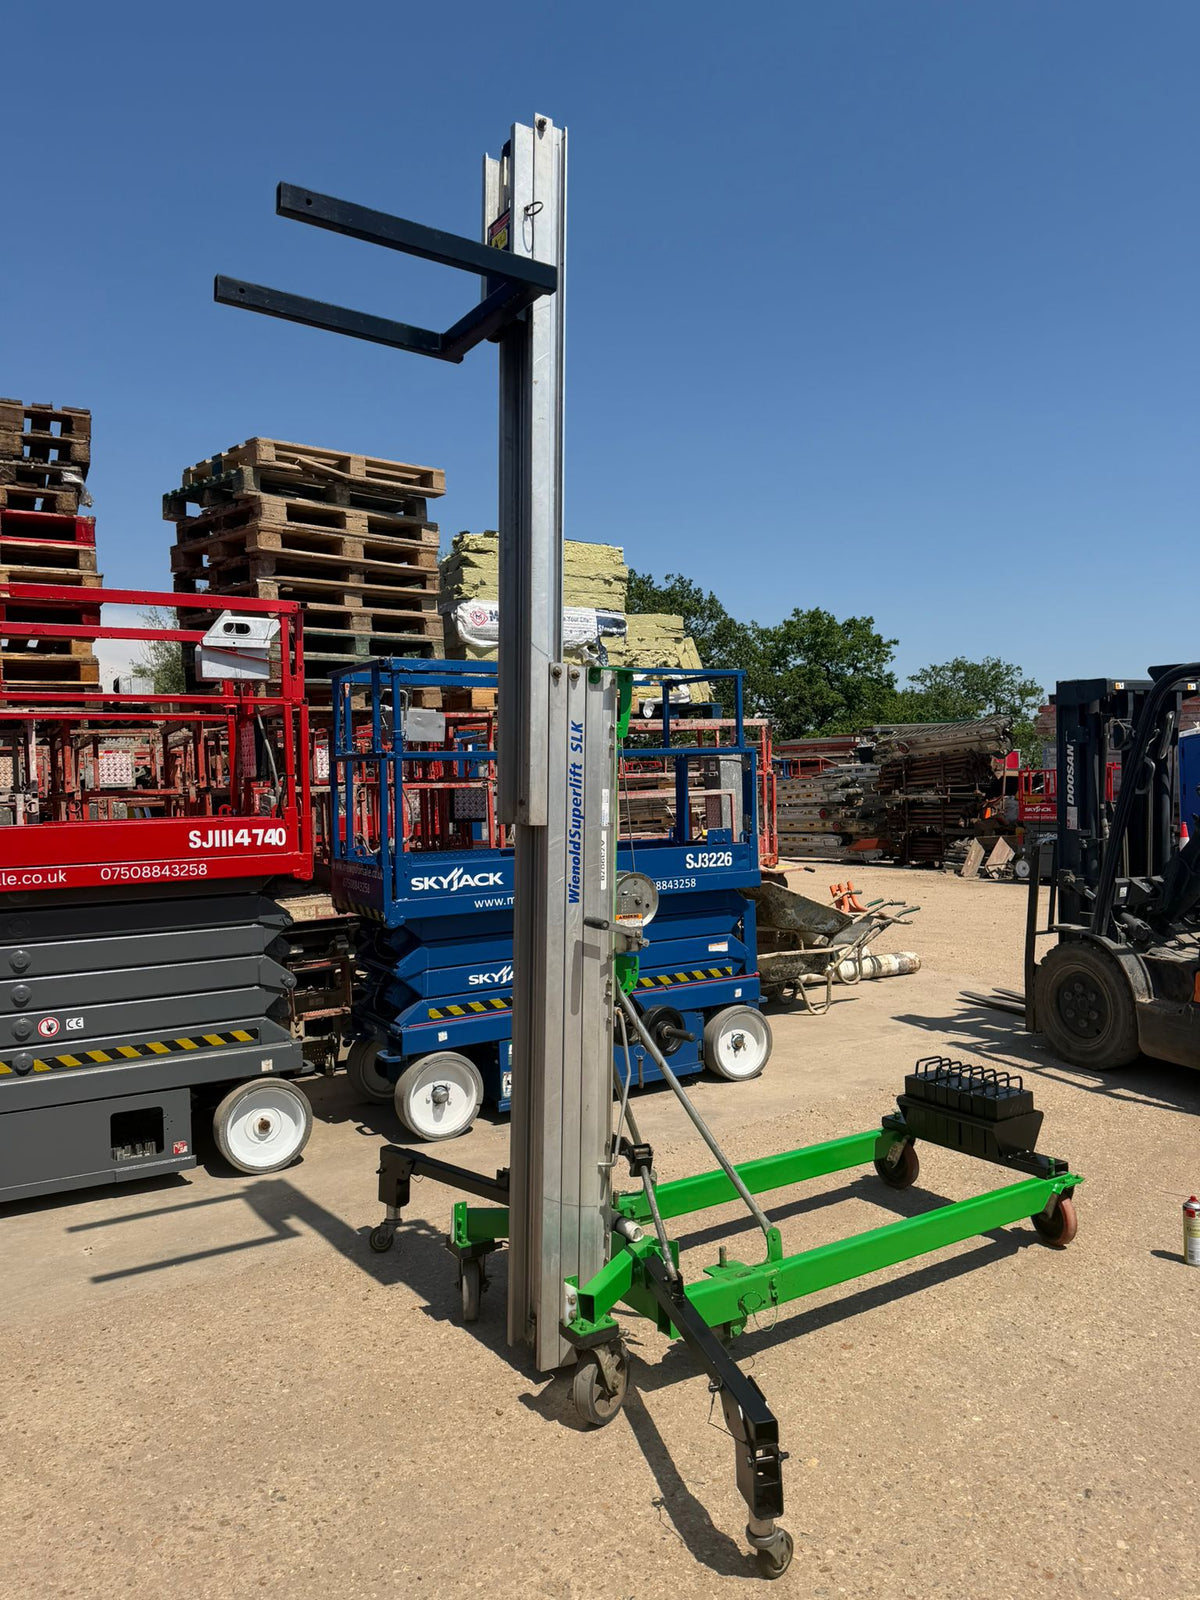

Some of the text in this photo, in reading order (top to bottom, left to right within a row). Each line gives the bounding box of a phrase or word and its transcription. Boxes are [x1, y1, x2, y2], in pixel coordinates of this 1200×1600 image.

[571, 720, 583, 753] SLK
[686, 852, 733, 869] SJ3226
[0, 863, 208, 886] le.co.uk 07508843258
[410, 866, 504, 892] SKYJACK
[654, 878, 696, 890] 8843258
